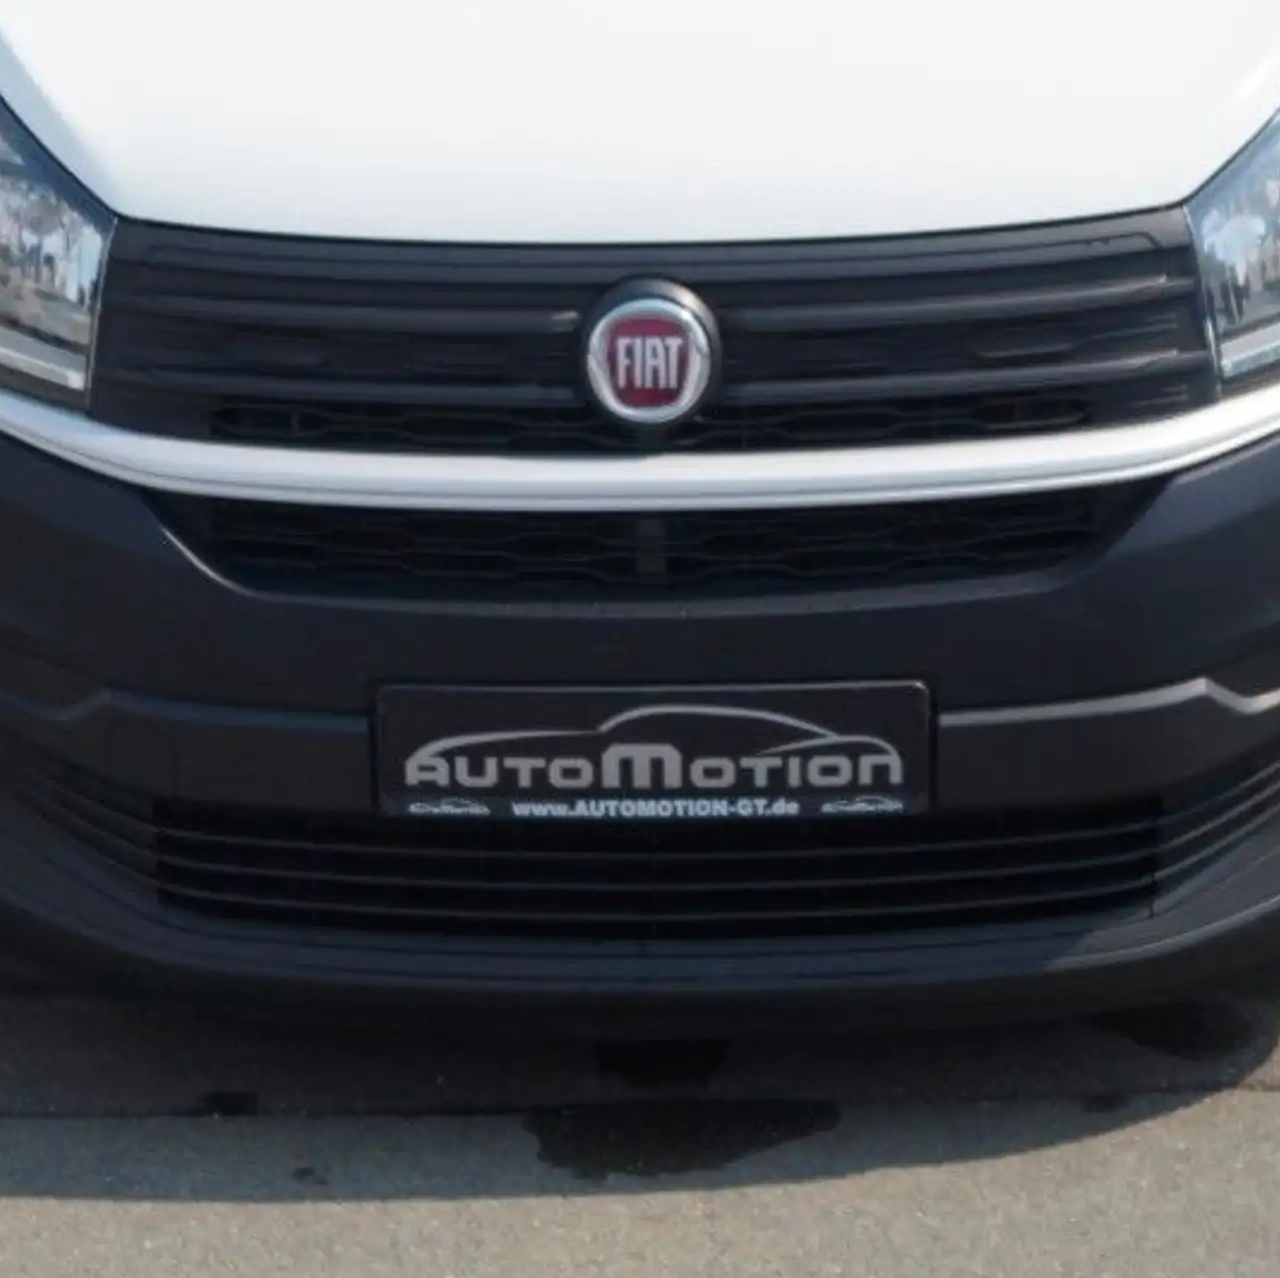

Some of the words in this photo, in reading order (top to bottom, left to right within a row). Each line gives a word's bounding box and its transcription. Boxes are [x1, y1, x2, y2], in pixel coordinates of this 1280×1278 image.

[616, 336, 683, 389] FIAT
[405, 744, 902, 789] AUTOMOTION
[512, 799, 800, 818] www.AUTOMOTION-GT.de
